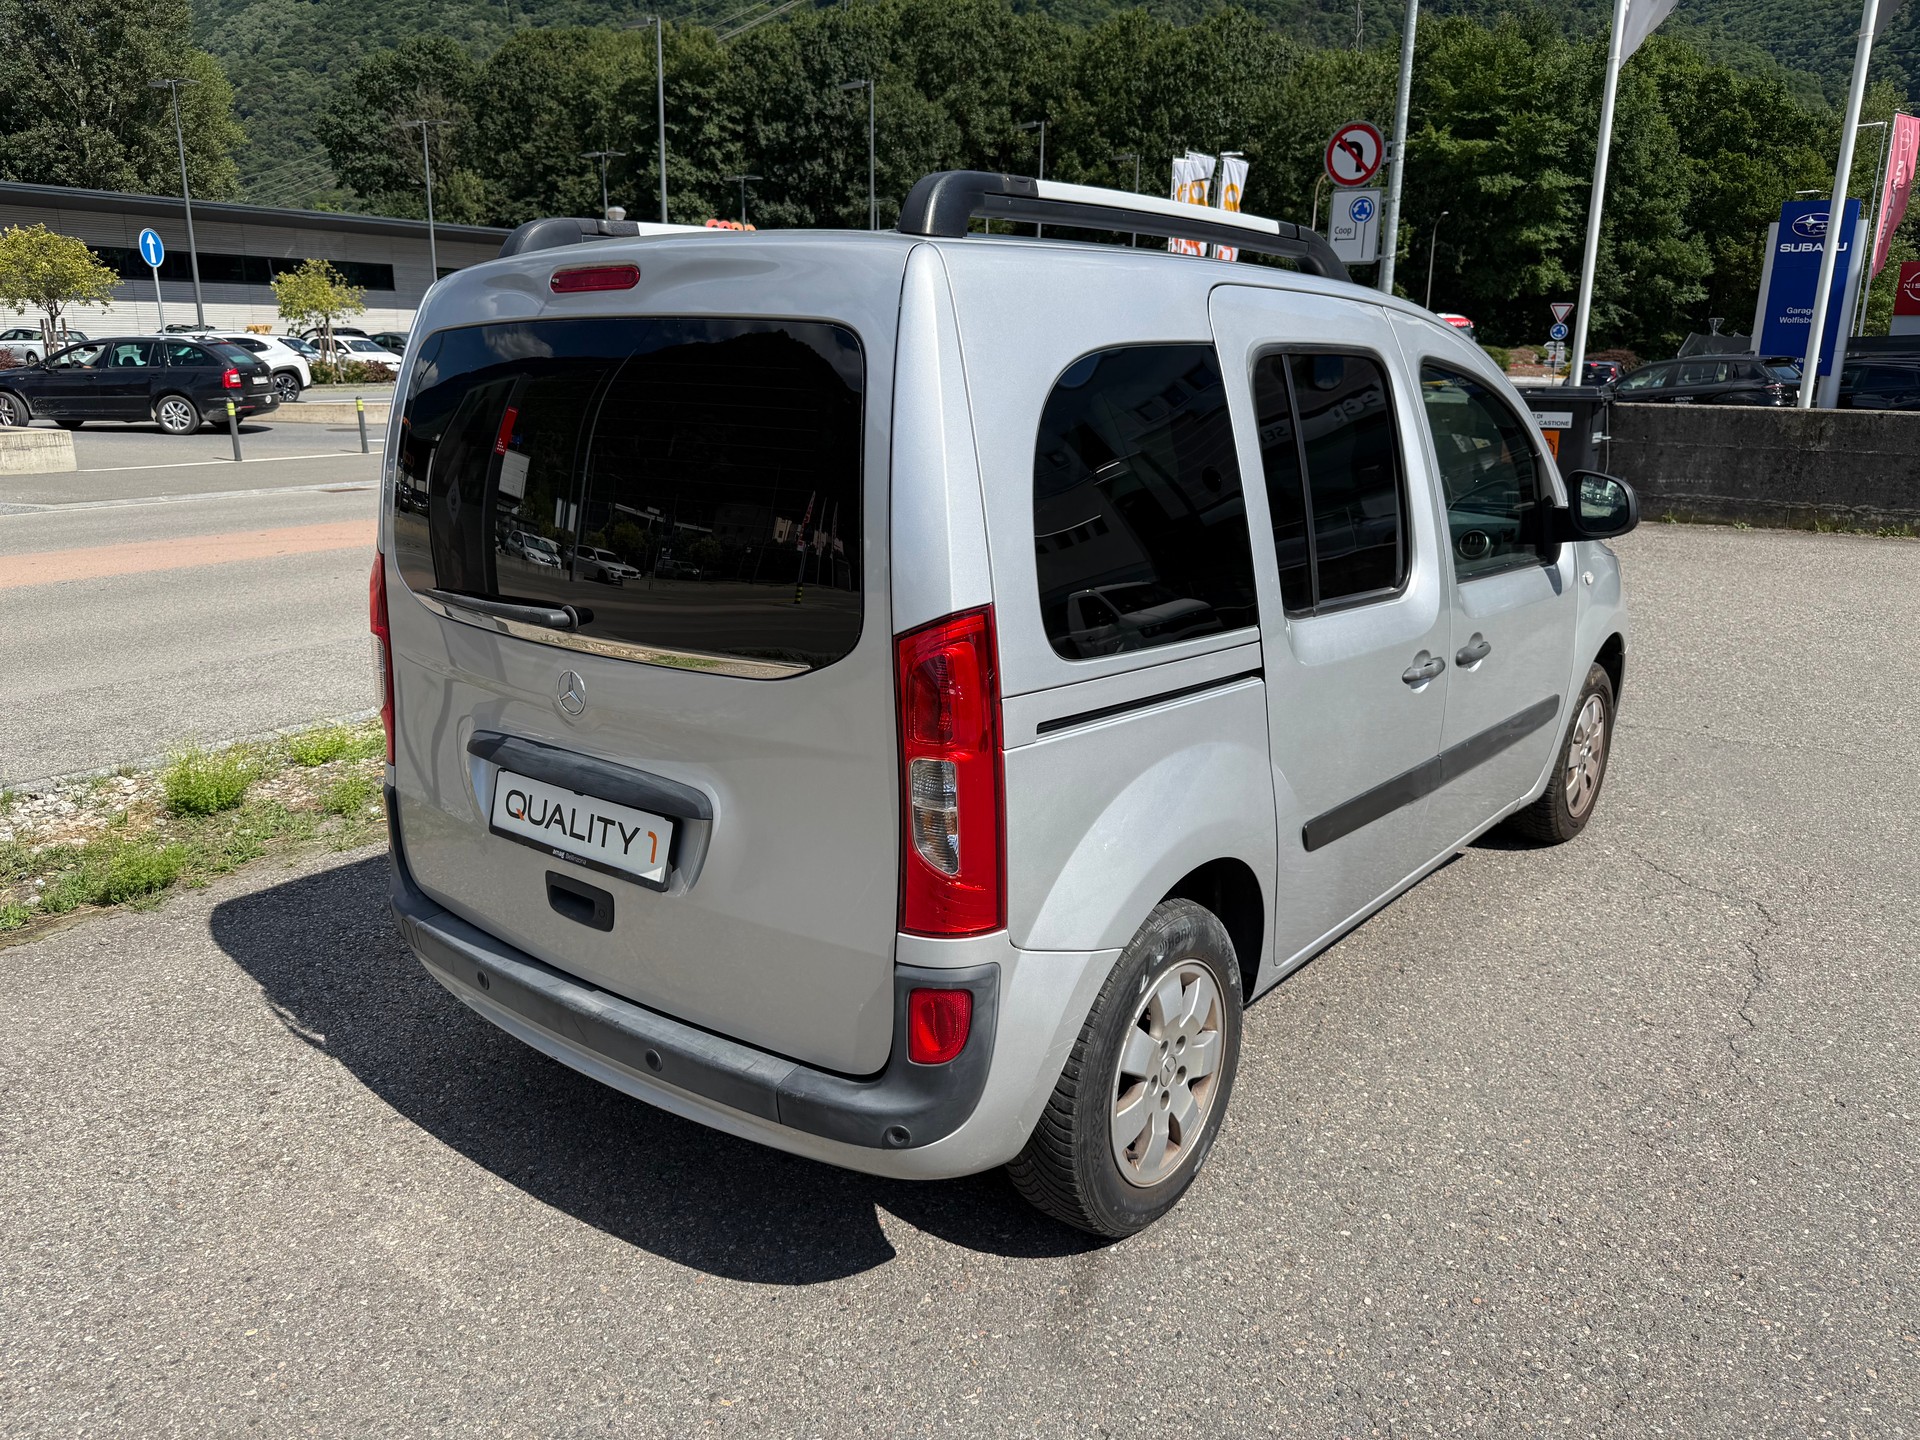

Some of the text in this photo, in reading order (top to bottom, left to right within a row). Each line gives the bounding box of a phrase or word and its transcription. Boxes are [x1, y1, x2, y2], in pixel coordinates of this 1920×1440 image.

[1334, 225, 1352, 236] Coop
[1779, 242, 1848, 253] SUBAU
[505, 789, 658, 864] QUALITY 1
